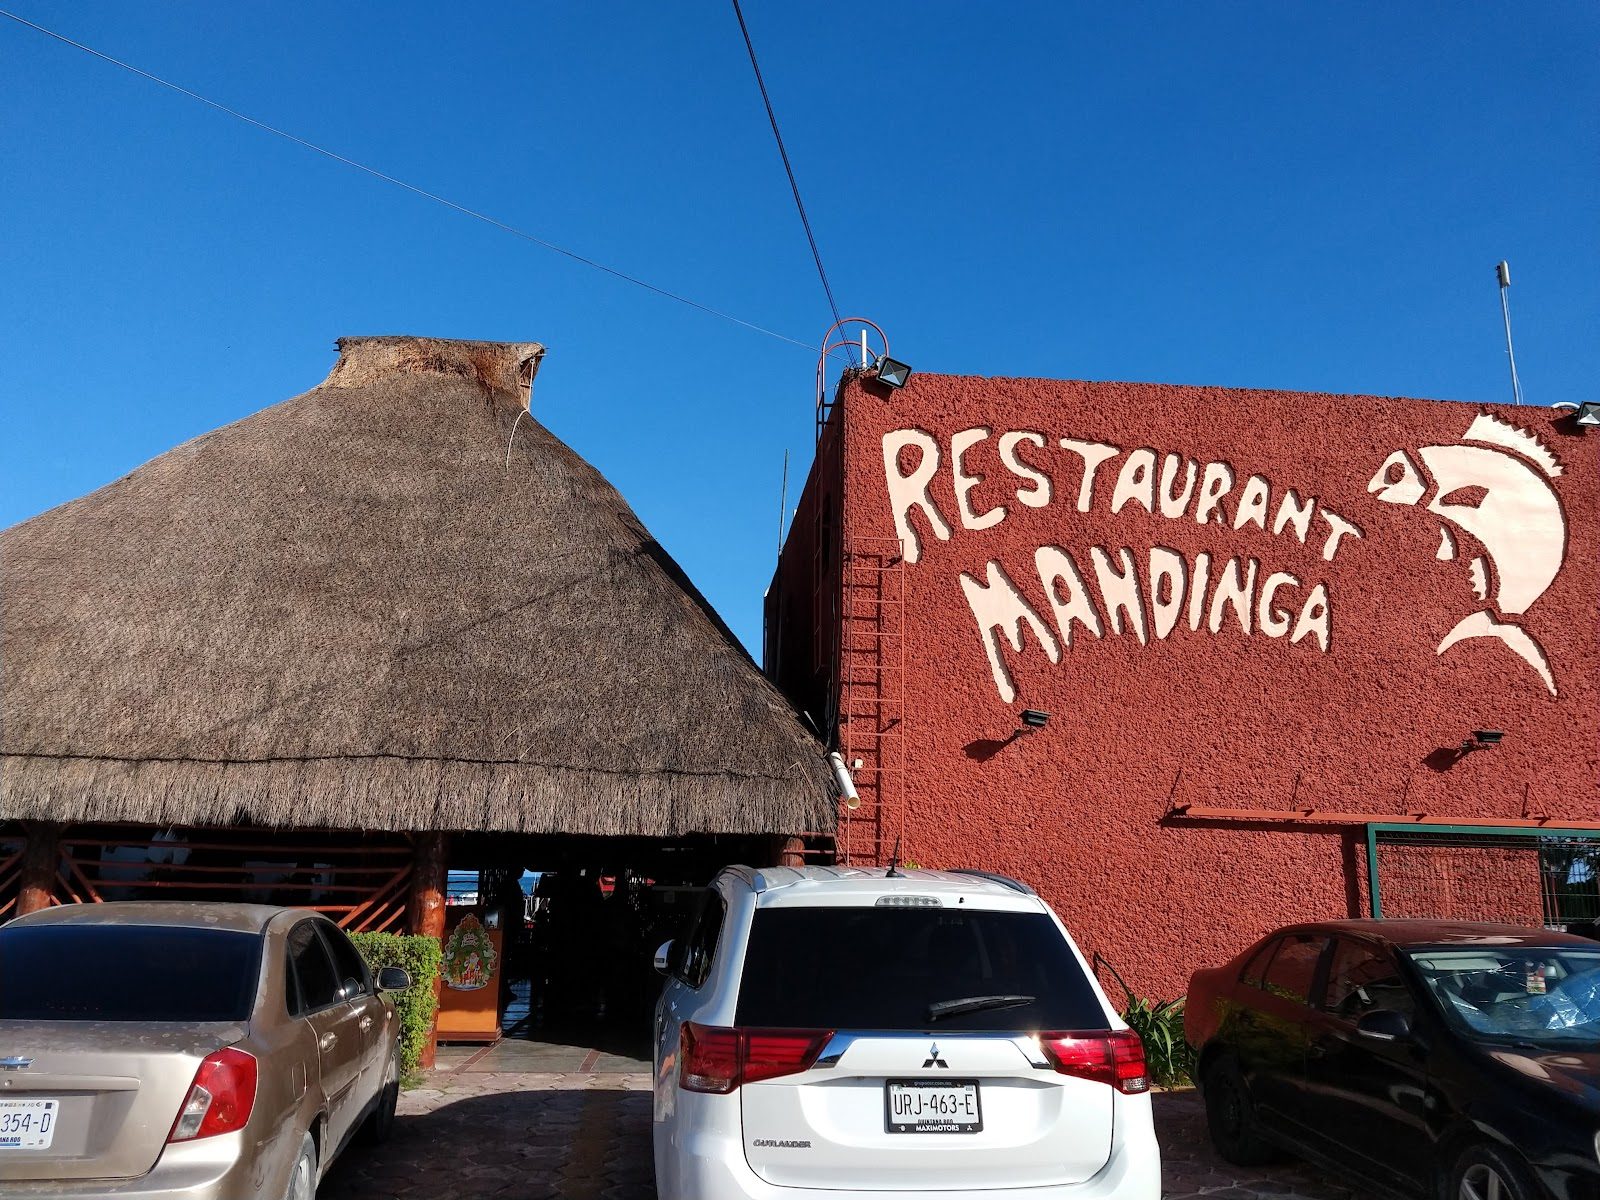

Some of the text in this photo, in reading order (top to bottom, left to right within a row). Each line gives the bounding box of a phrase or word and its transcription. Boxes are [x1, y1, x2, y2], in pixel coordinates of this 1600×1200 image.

[882, 426, 1364, 563] RESTAURANT
[958, 545, 1331, 703] MANDINGA
[894, 1094, 975, 1115] URJ-463-E
[0, 1113, 51, 1133] 354-D
[752, 1139, 812, 1148] OUTLANDER
